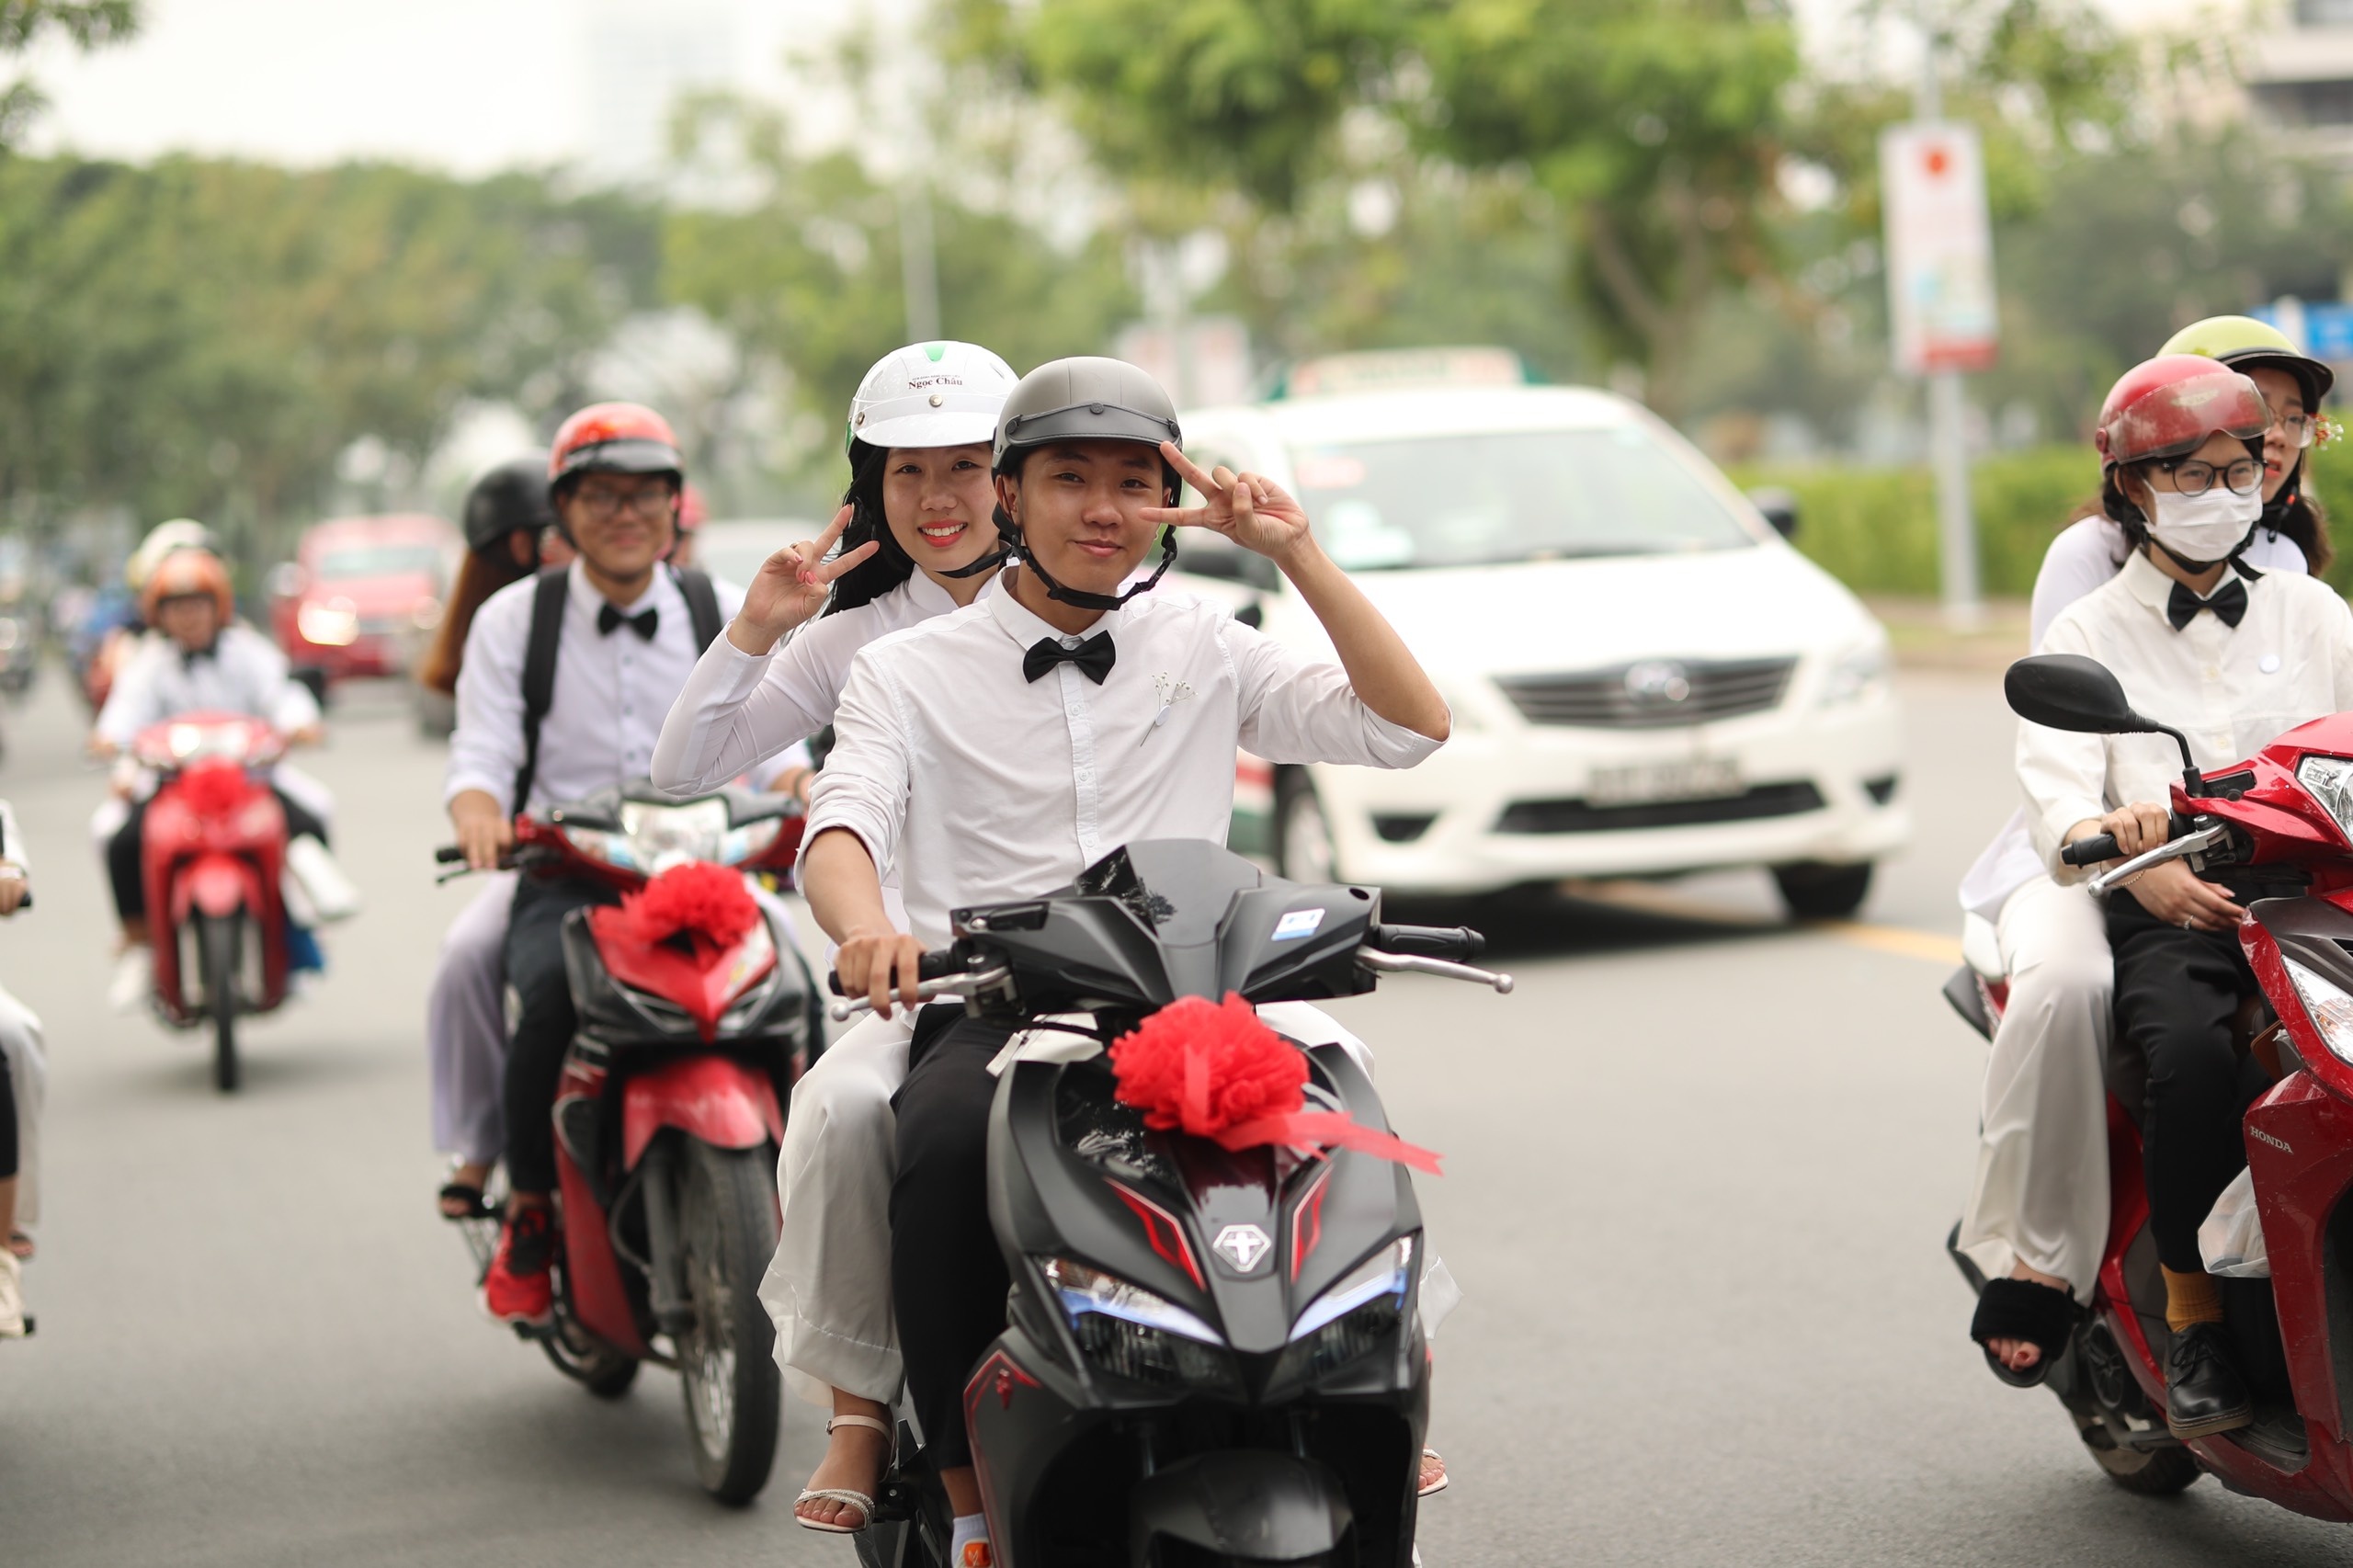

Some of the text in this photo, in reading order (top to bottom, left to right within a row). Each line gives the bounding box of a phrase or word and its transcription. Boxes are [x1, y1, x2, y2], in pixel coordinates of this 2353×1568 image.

[908, 380, 933, 390] Ngọc
[936, 377, 962, 386] Châu
[2250, 1126, 2294, 1154] HONDA
